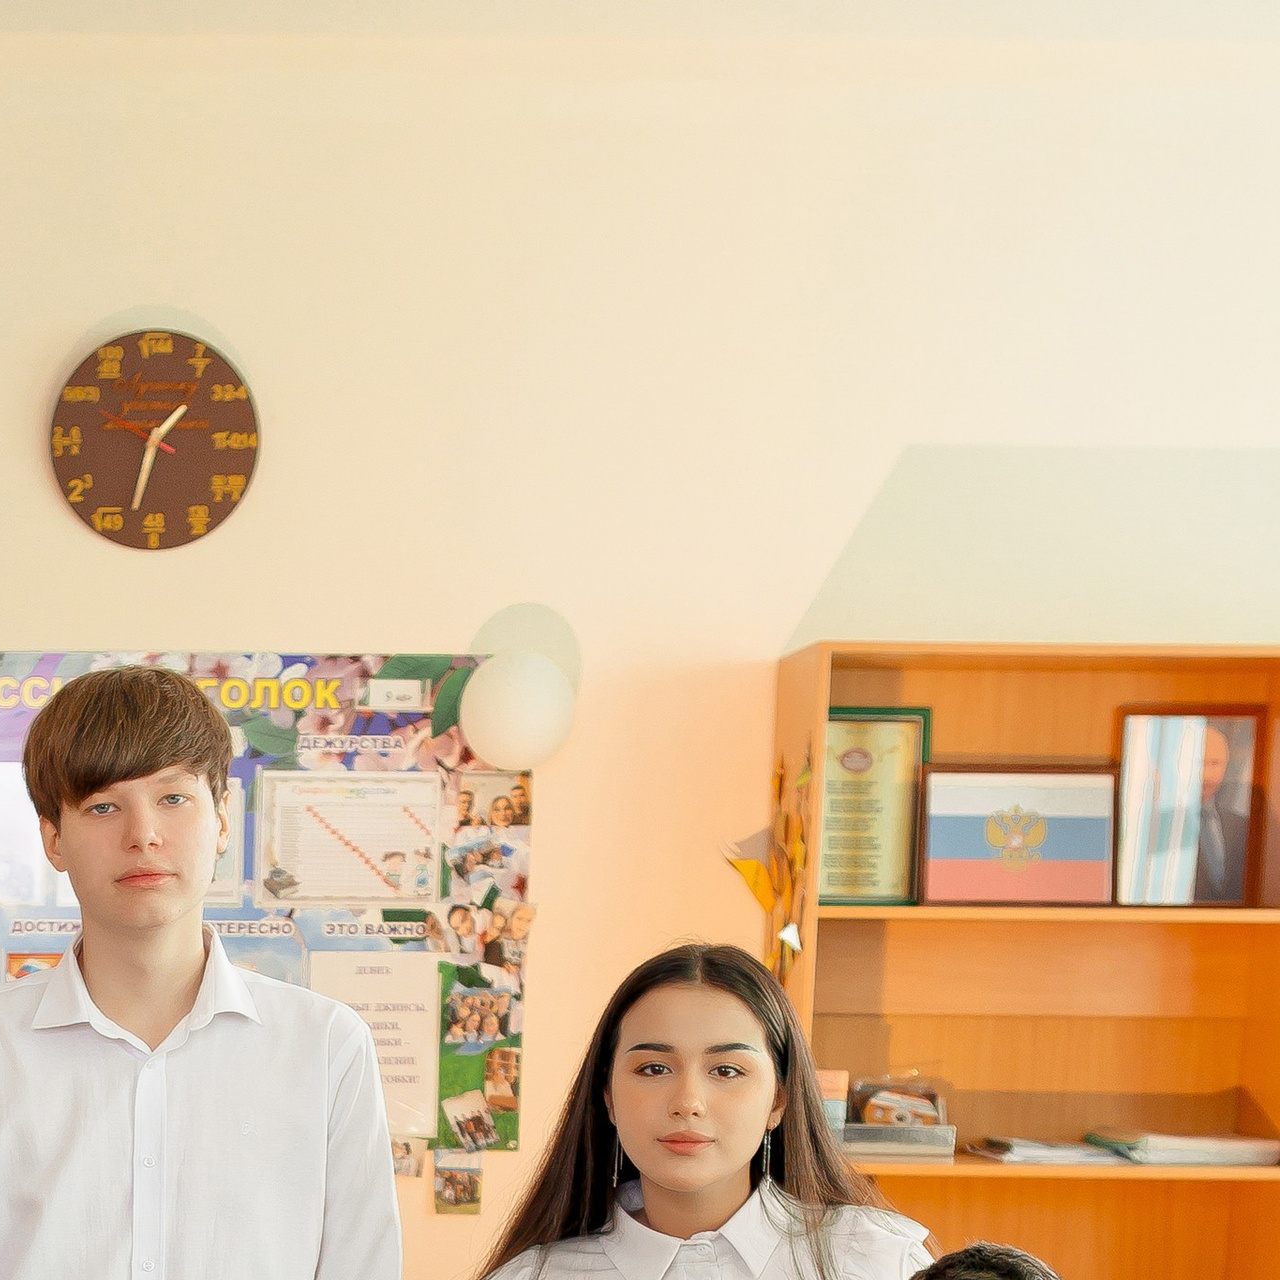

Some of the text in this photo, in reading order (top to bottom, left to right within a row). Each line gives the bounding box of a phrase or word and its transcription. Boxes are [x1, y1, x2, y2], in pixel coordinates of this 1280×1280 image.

[300, 737, 403, 750] ДЕЖУРСТВА
[325, 923, 426, 935] ЭТО ВАЖНО
